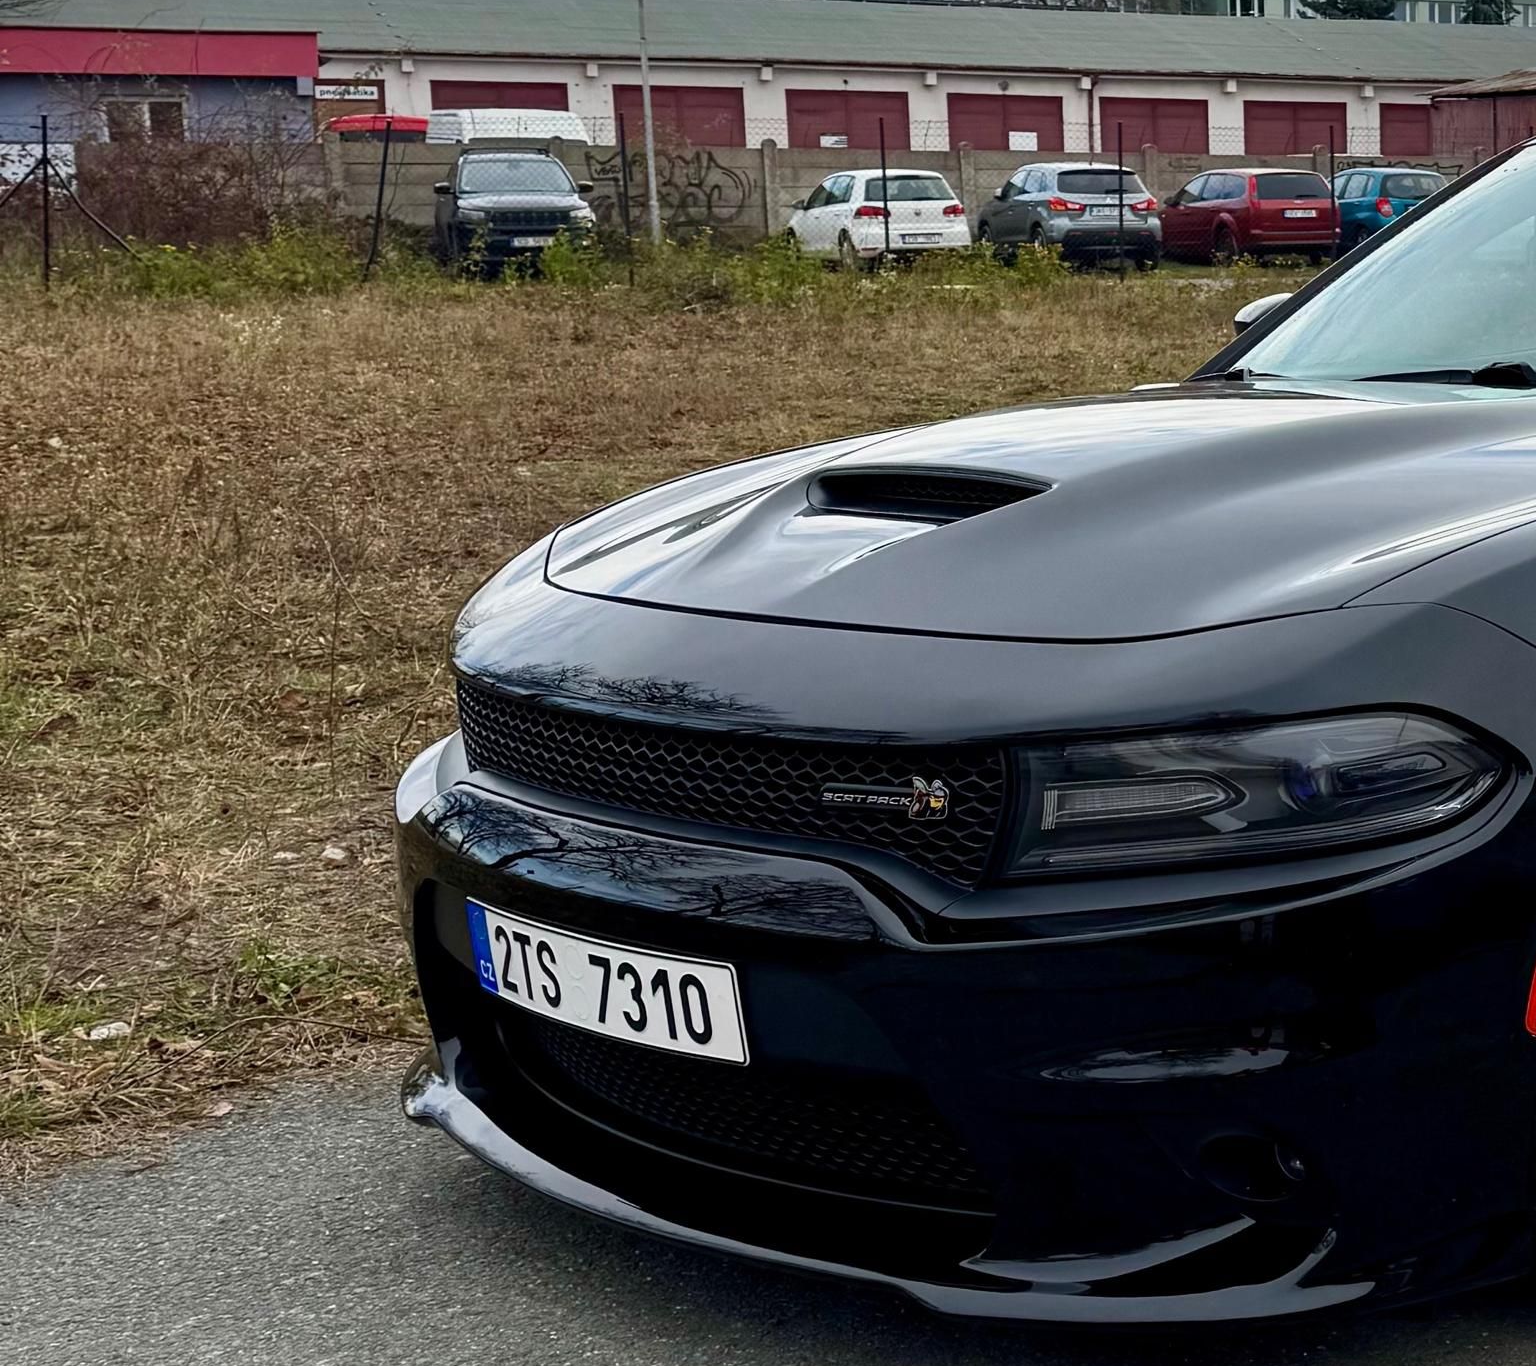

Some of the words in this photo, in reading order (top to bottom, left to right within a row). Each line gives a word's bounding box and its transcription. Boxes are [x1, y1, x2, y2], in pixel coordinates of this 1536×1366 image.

[319, 88, 375, 97] pneatika
[821, 792, 867, 803] SCAT
[866, 795, 912, 806] PACK
[480, 958, 496, 982] CZ
[495, 924, 562, 1009] 2TS
[587, 953, 713, 1045] 7310
